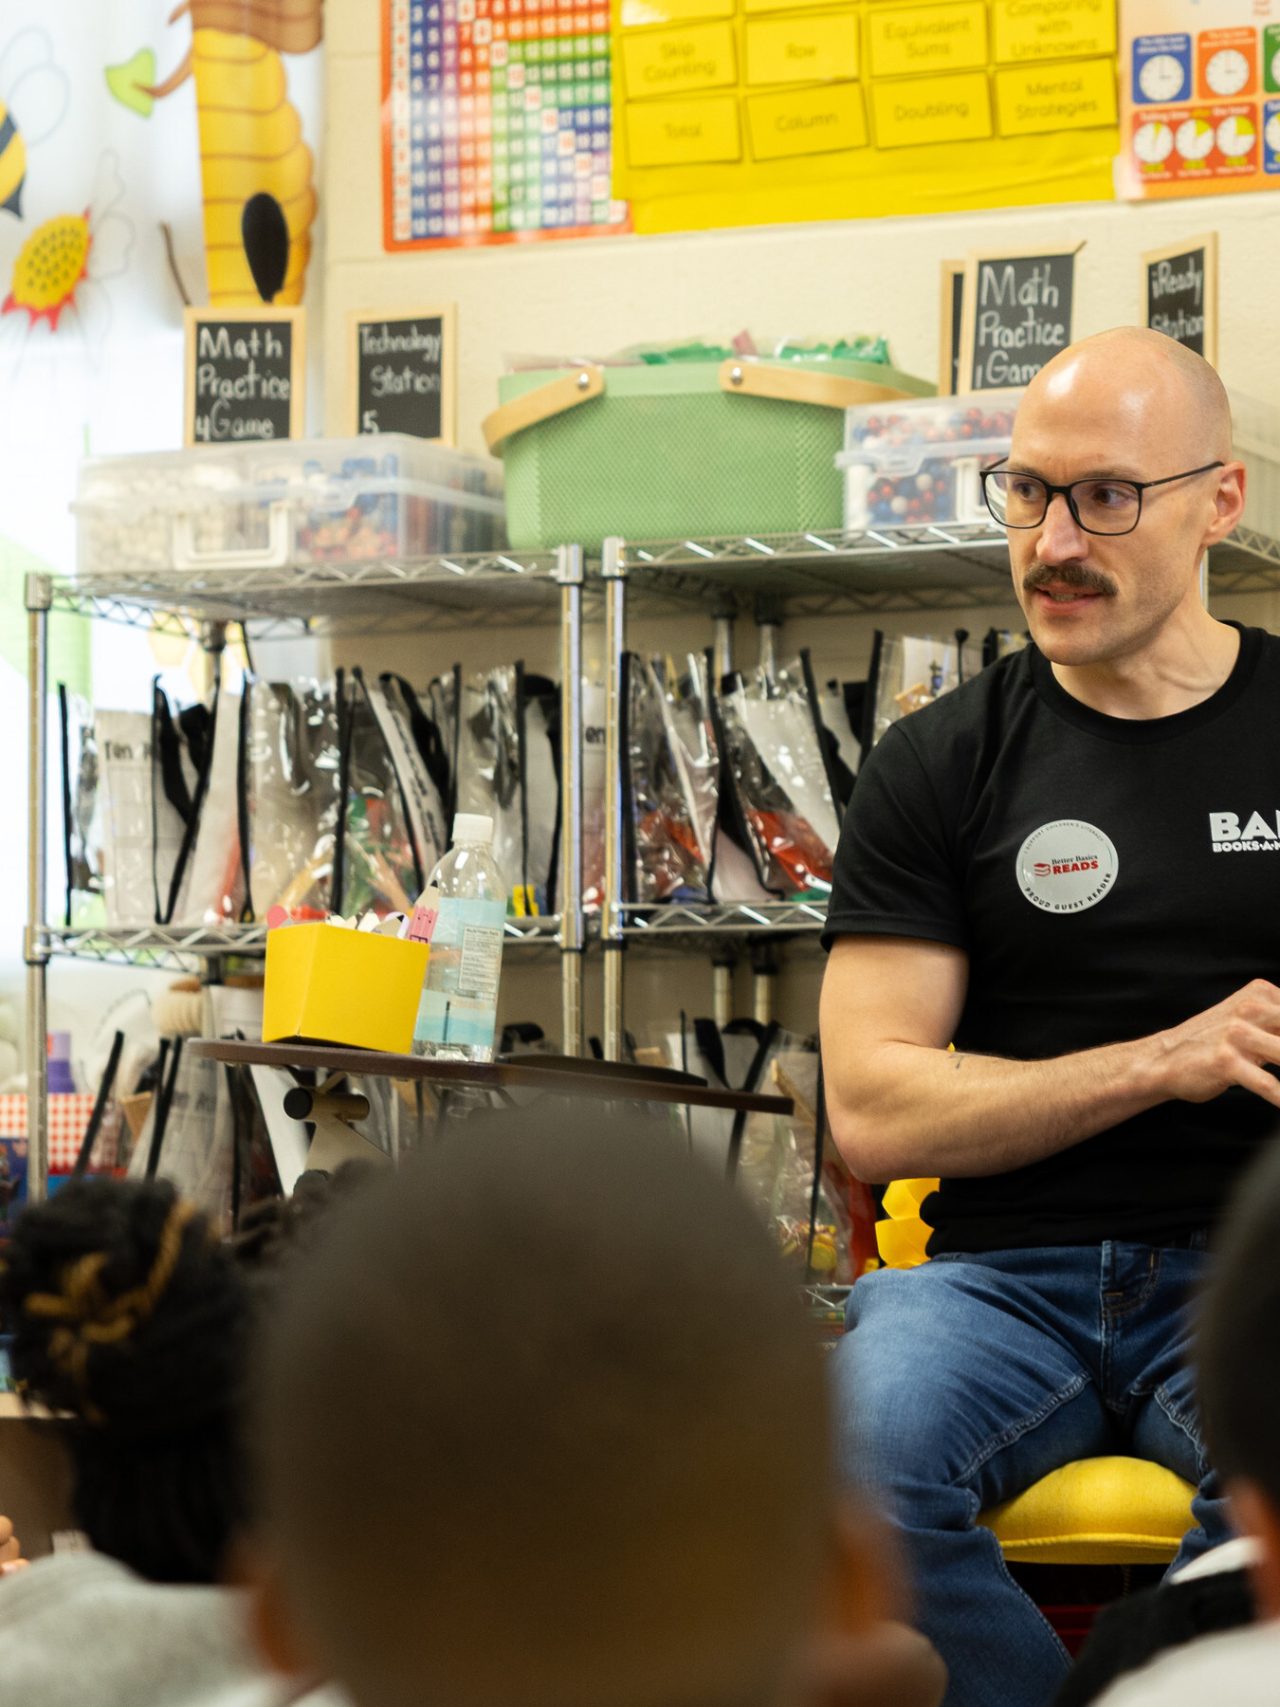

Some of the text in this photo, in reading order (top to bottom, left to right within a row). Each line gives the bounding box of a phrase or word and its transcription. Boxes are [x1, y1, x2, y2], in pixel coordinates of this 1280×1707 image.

[883, 17, 971, 39] Equivalent
[1036, 18, 1072, 34] with
[784, 42, 817, 59] Row
[906, 42, 950, 59] Sums
[1011, 37, 1099, 58] Unknowns
[643, 59, 717, 82] Counting
[1025, 78, 1083, 97] Mental
[894, 101, 970, 122] Doubling
[1016, 98, 1098, 121] Strategies
[775, 112, 839, 133] Column
[980, 263, 1060, 308] Math
[1150, 256, 1203, 305] iReady
[978, 306, 1066, 348] Practice
[200, 326, 283, 360] Math
[360, 321, 441, 362] Technology
[197, 358, 291, 400] Practice
[986, 351, 1042, 385] Gam
[369, 363, 440, 398] Station
[362, 409, 379, 434] 5
[1051, 853, 1099, 866] Better Basics
[1052, 859, 1100, 876] READS
[1024, 872, 1112, 911] PROUD GUEST READER
